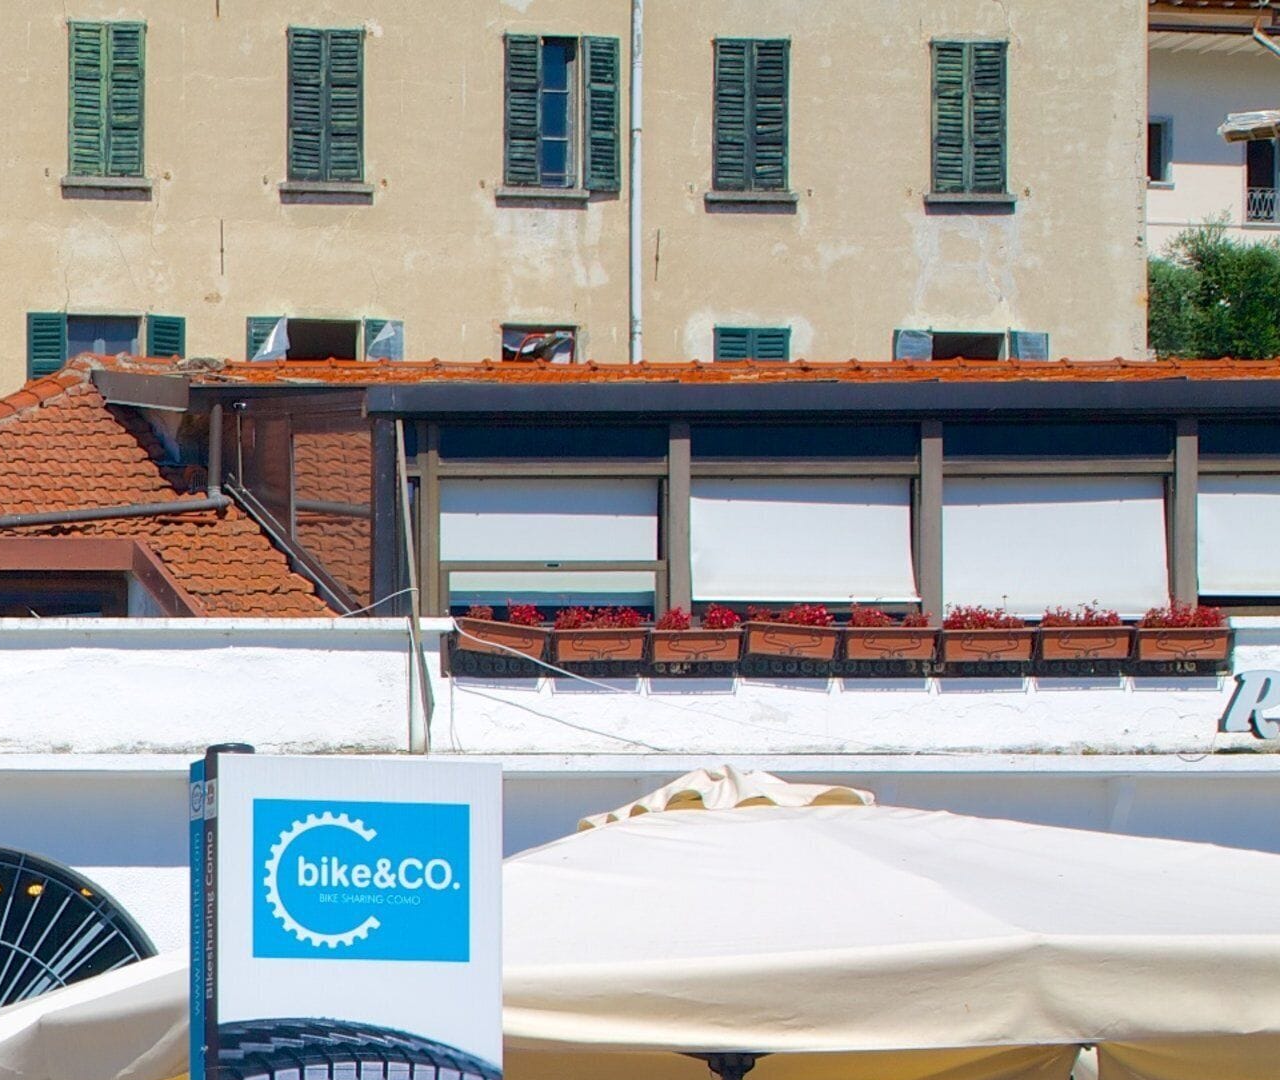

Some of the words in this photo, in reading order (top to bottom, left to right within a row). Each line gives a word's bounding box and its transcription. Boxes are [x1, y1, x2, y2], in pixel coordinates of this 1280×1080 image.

[297, 855, 461, 890] bike&CO.
[319, 893, 338, 904] BIKE
[342, 893, 384, 905] SHARING
[386, 894, 421, 906] COMO
[206, 889, 215, 1000] Bikesharing
